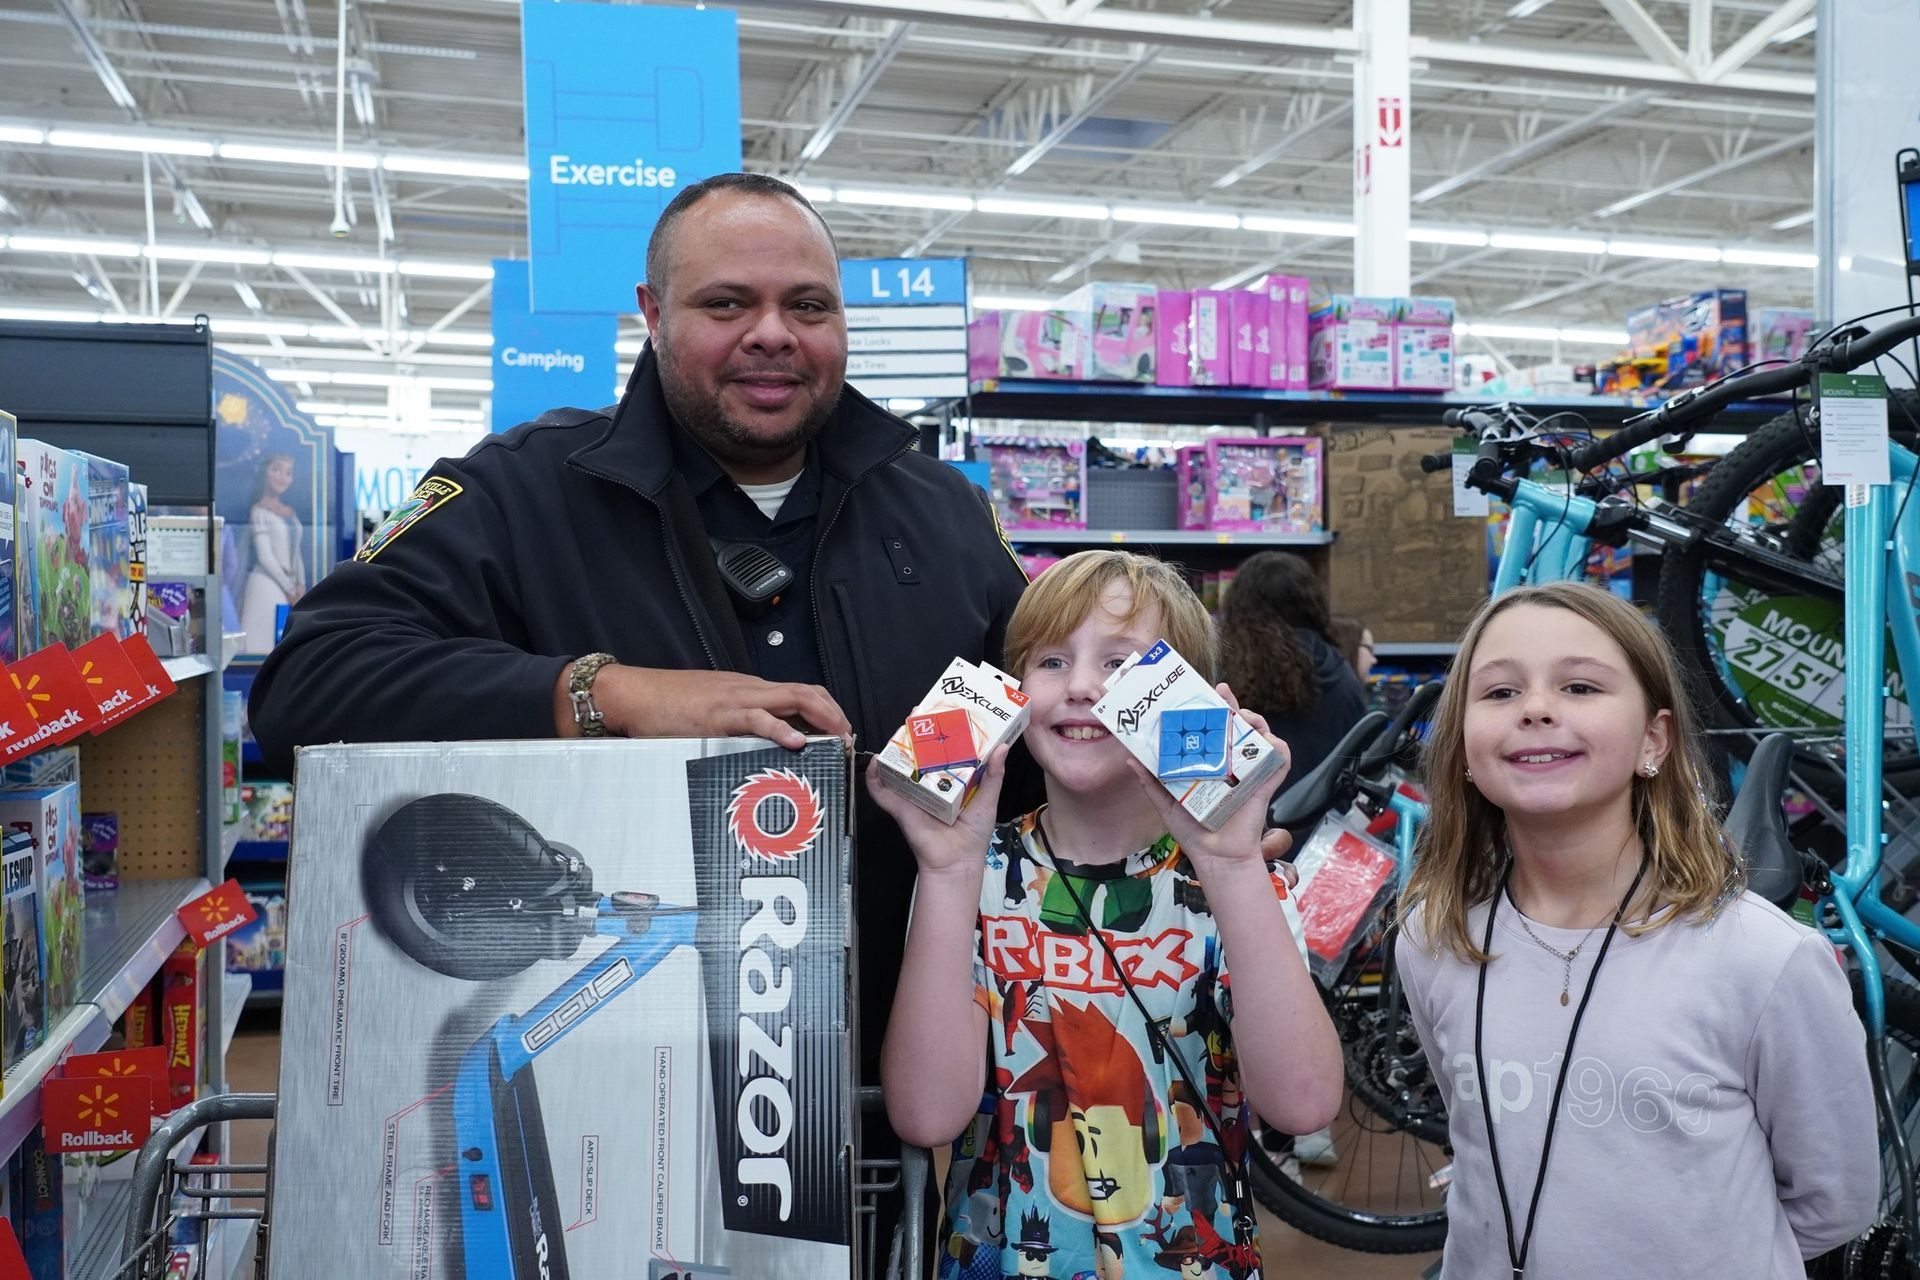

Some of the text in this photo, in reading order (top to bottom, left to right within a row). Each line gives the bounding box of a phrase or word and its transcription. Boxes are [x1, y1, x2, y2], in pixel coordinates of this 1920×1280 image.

[550, 156, 676, 187] Exercise
[871, 267, 935, 298] L 14
[502, 346, 585, 373] Camping
[1148, 646, 1163, 661] 3x3
[1733, 637, 1832, 690] 27.5"
[941, 675, 1012, 722] NEXCUBE
[1010, 691, 1024, 702] 2x2
[1116, 664, 1186, 736] NEXCUBE
[203, 913, 247, 942] Rollback
[171, 1004, 192, 1068] HEDBANZ
[335, 990, 345, 1044] PNEUMATIC
[333, 1045, 342, 1078] FRONT
[737, 876, 808, 1222] Razor
[332, 1079, 340, 1100] TIRE
[658, 1051, 666, 1136] HAND-OPERATED
[61, 1130, 134, 1147] Rollback
[657, 1138, 665, 1172] FRONT
[34, 1149, 50, 1199] CONNECT
[382, 1123, 395, 1240] STEEL FRAME AND FORK
[585, 1140, 594, 1215] ANTI-SLIP DECK
[422, 1185, 432, 1264] RECHARGEABLE
